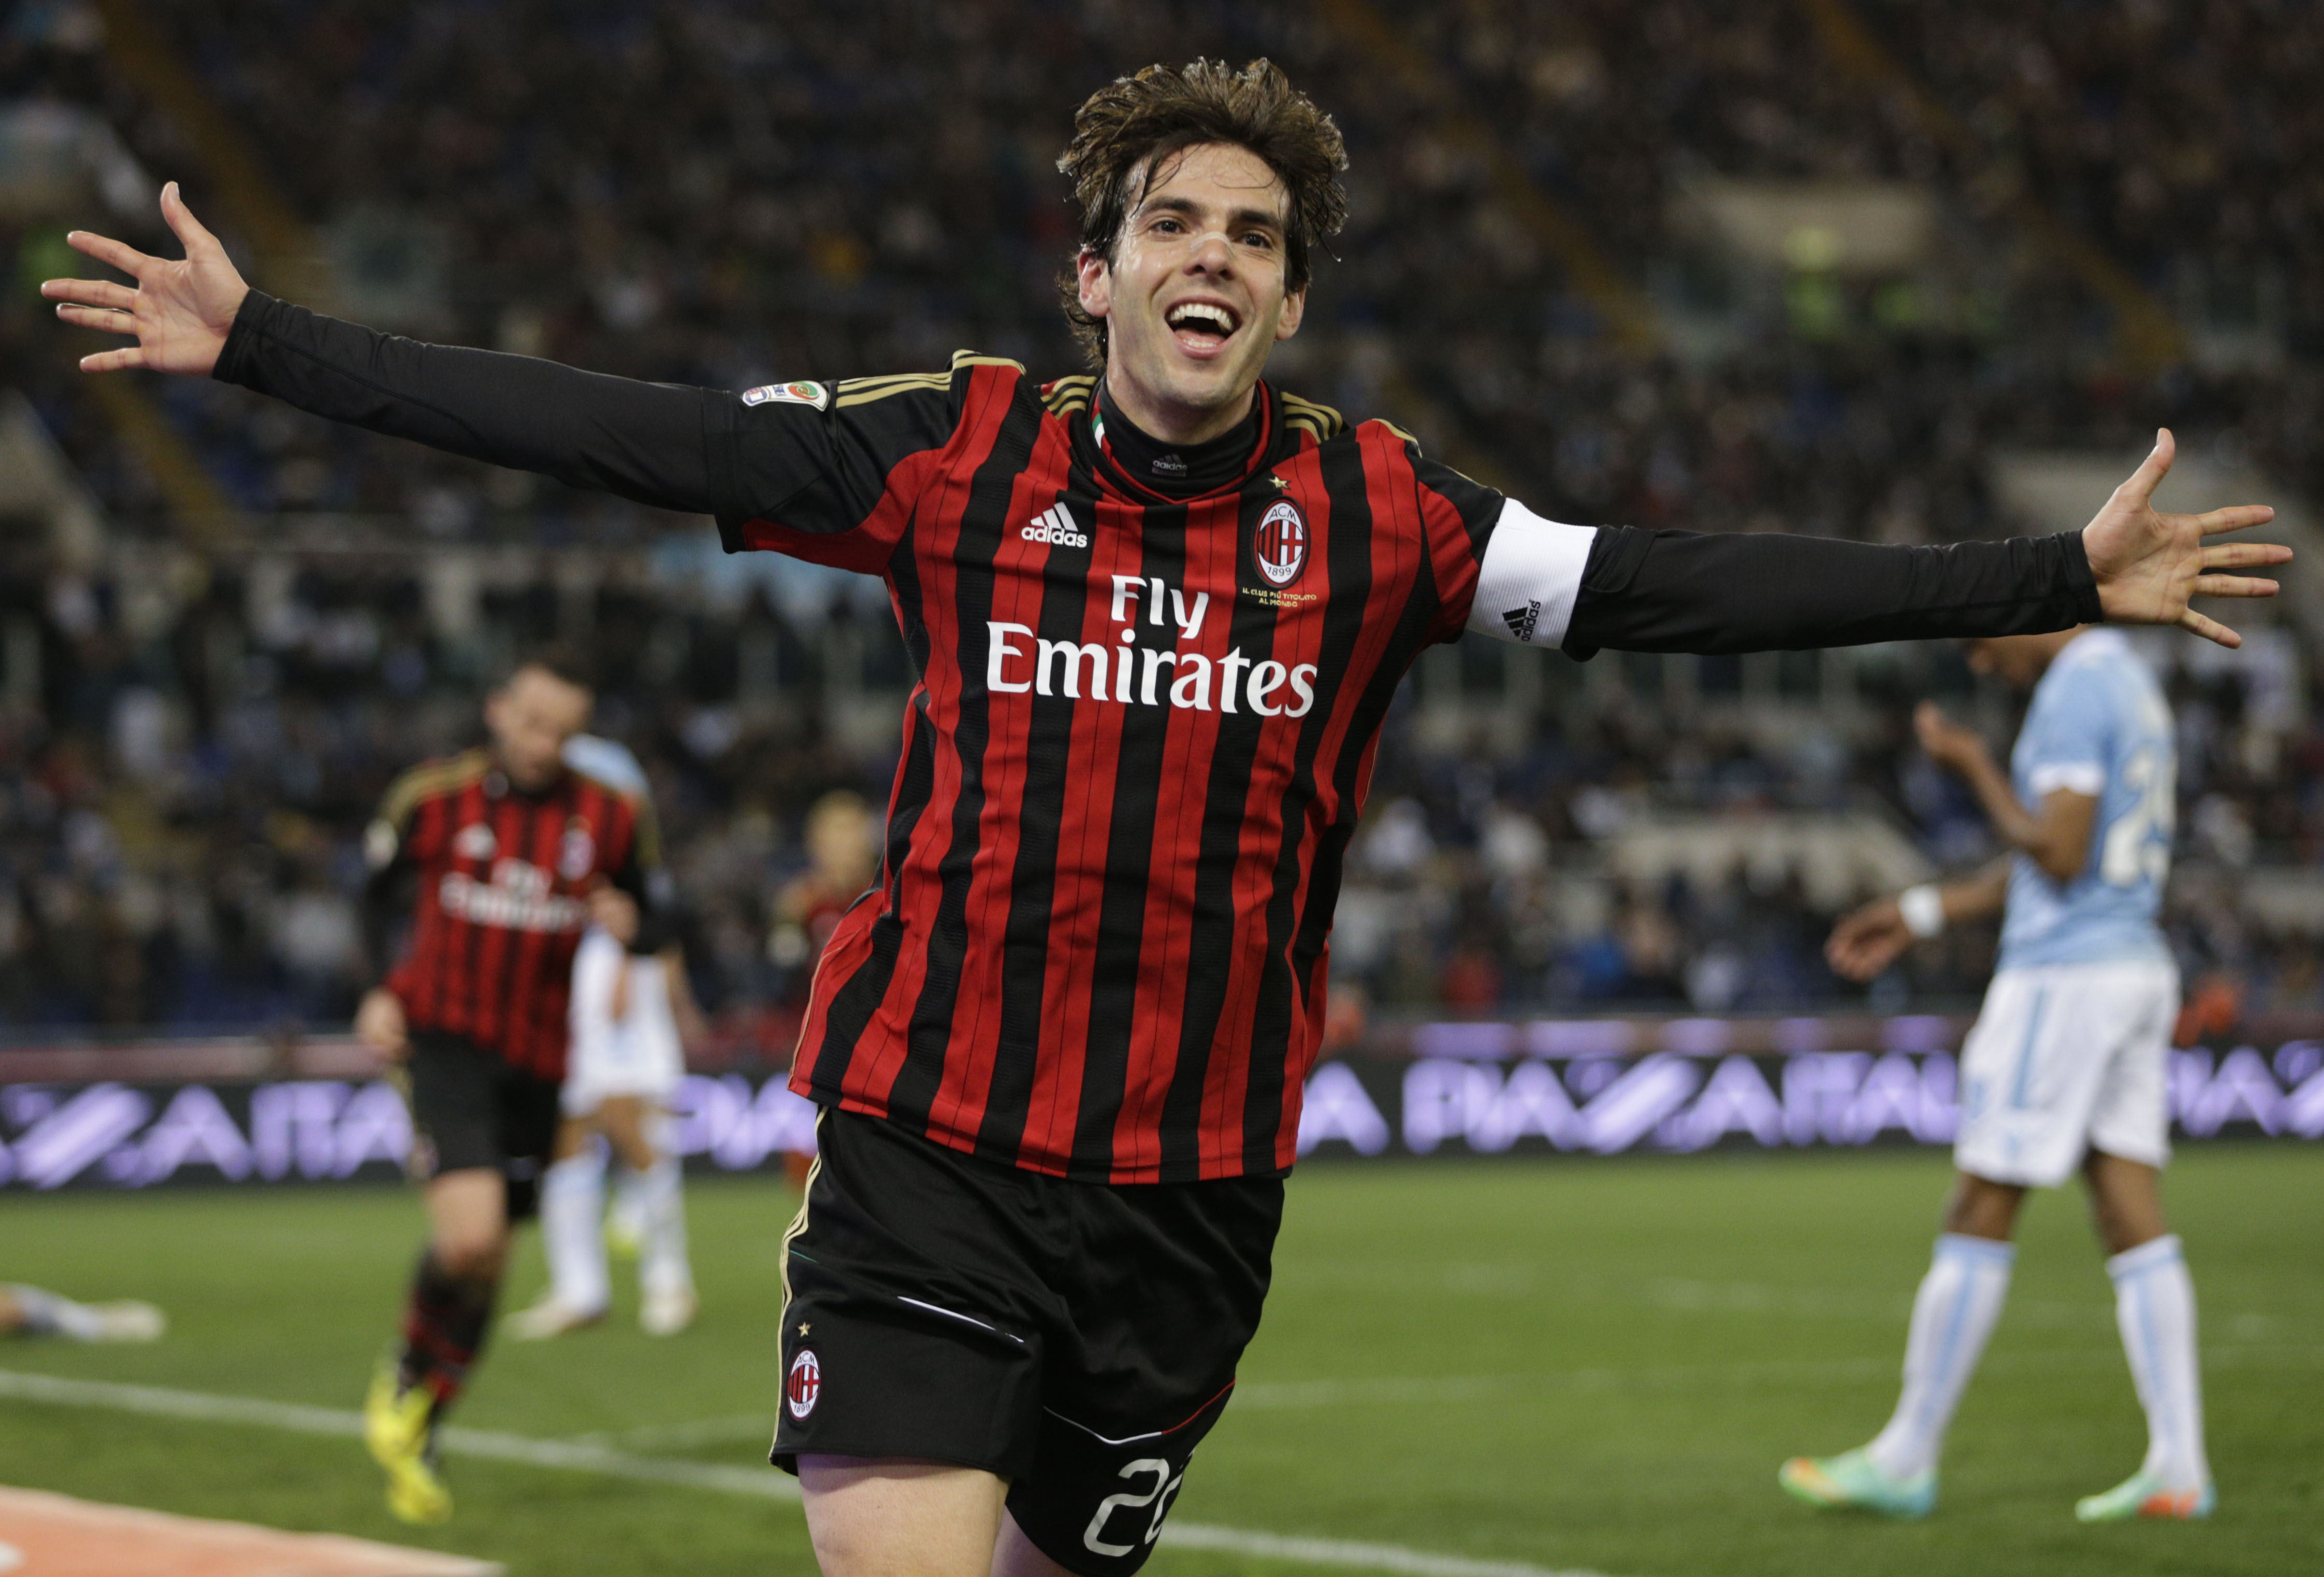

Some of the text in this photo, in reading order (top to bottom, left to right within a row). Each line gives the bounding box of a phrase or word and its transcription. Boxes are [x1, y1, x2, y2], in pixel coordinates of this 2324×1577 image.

[1268, 505, 1296, 522] ACM
[1021, 525, 1088, 548] adidas
[1267, 566, 1292, 576] 1899
[1250, 588, 1267, 597] CLUB
[1111, 574, 1210, 639] Fly
[1521, 600, 1541, 642] adidas
[986, 621, 1318, 718] Emirates
[796, 1353, 815, 1366] ACM
[794, 1403, 810, 1413] 1899
